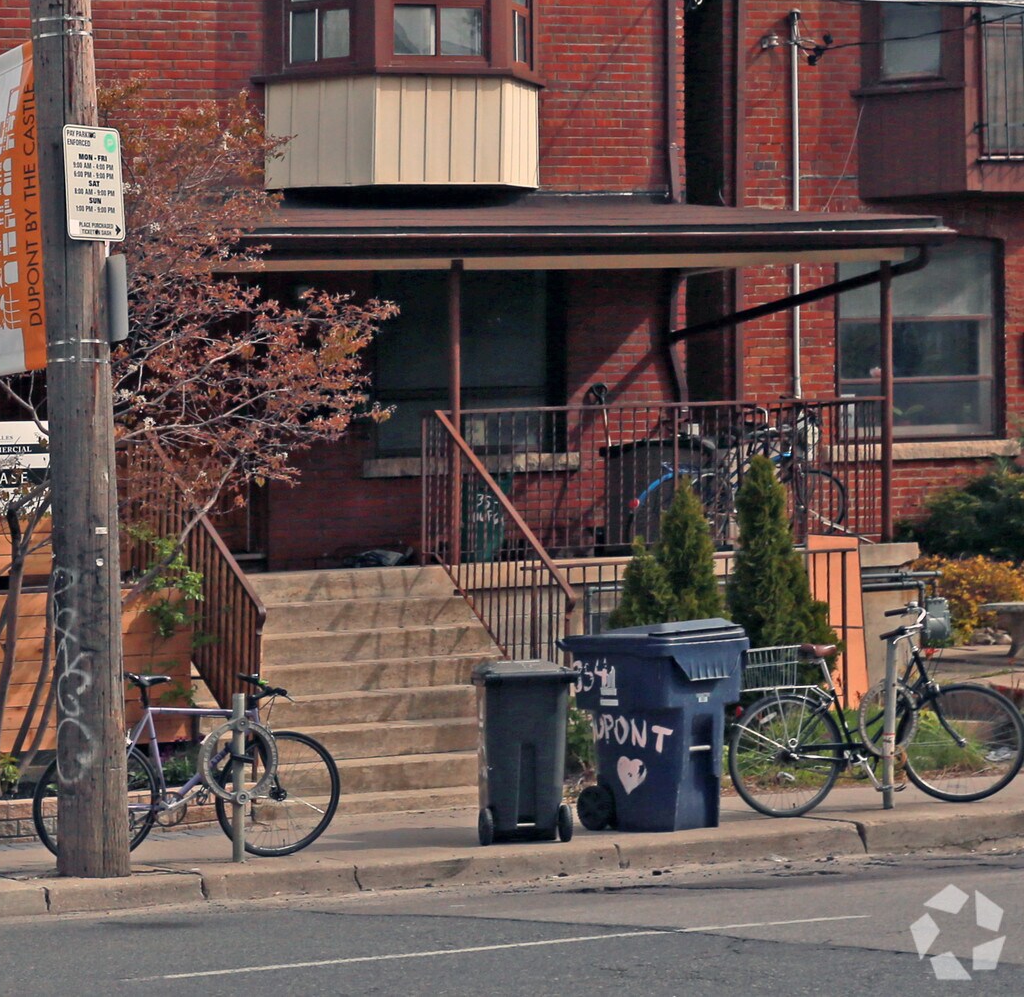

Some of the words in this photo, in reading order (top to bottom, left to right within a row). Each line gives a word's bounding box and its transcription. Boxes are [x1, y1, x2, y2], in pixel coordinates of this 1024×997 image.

[23, 83, 35, 156] CASTLE
[67, 129, 75, 137] PAY
[76, 130, 96, 139] PARKIG
[67, 138, 91, 147] ENFORCED
[78, 153, 93, 161] MON
[97, 154, 108, 162] FRI
[23, 163, 36, 201] THE
[25, 208, 38, 232] BY
[26, 240, 42, 327] DUPONT
